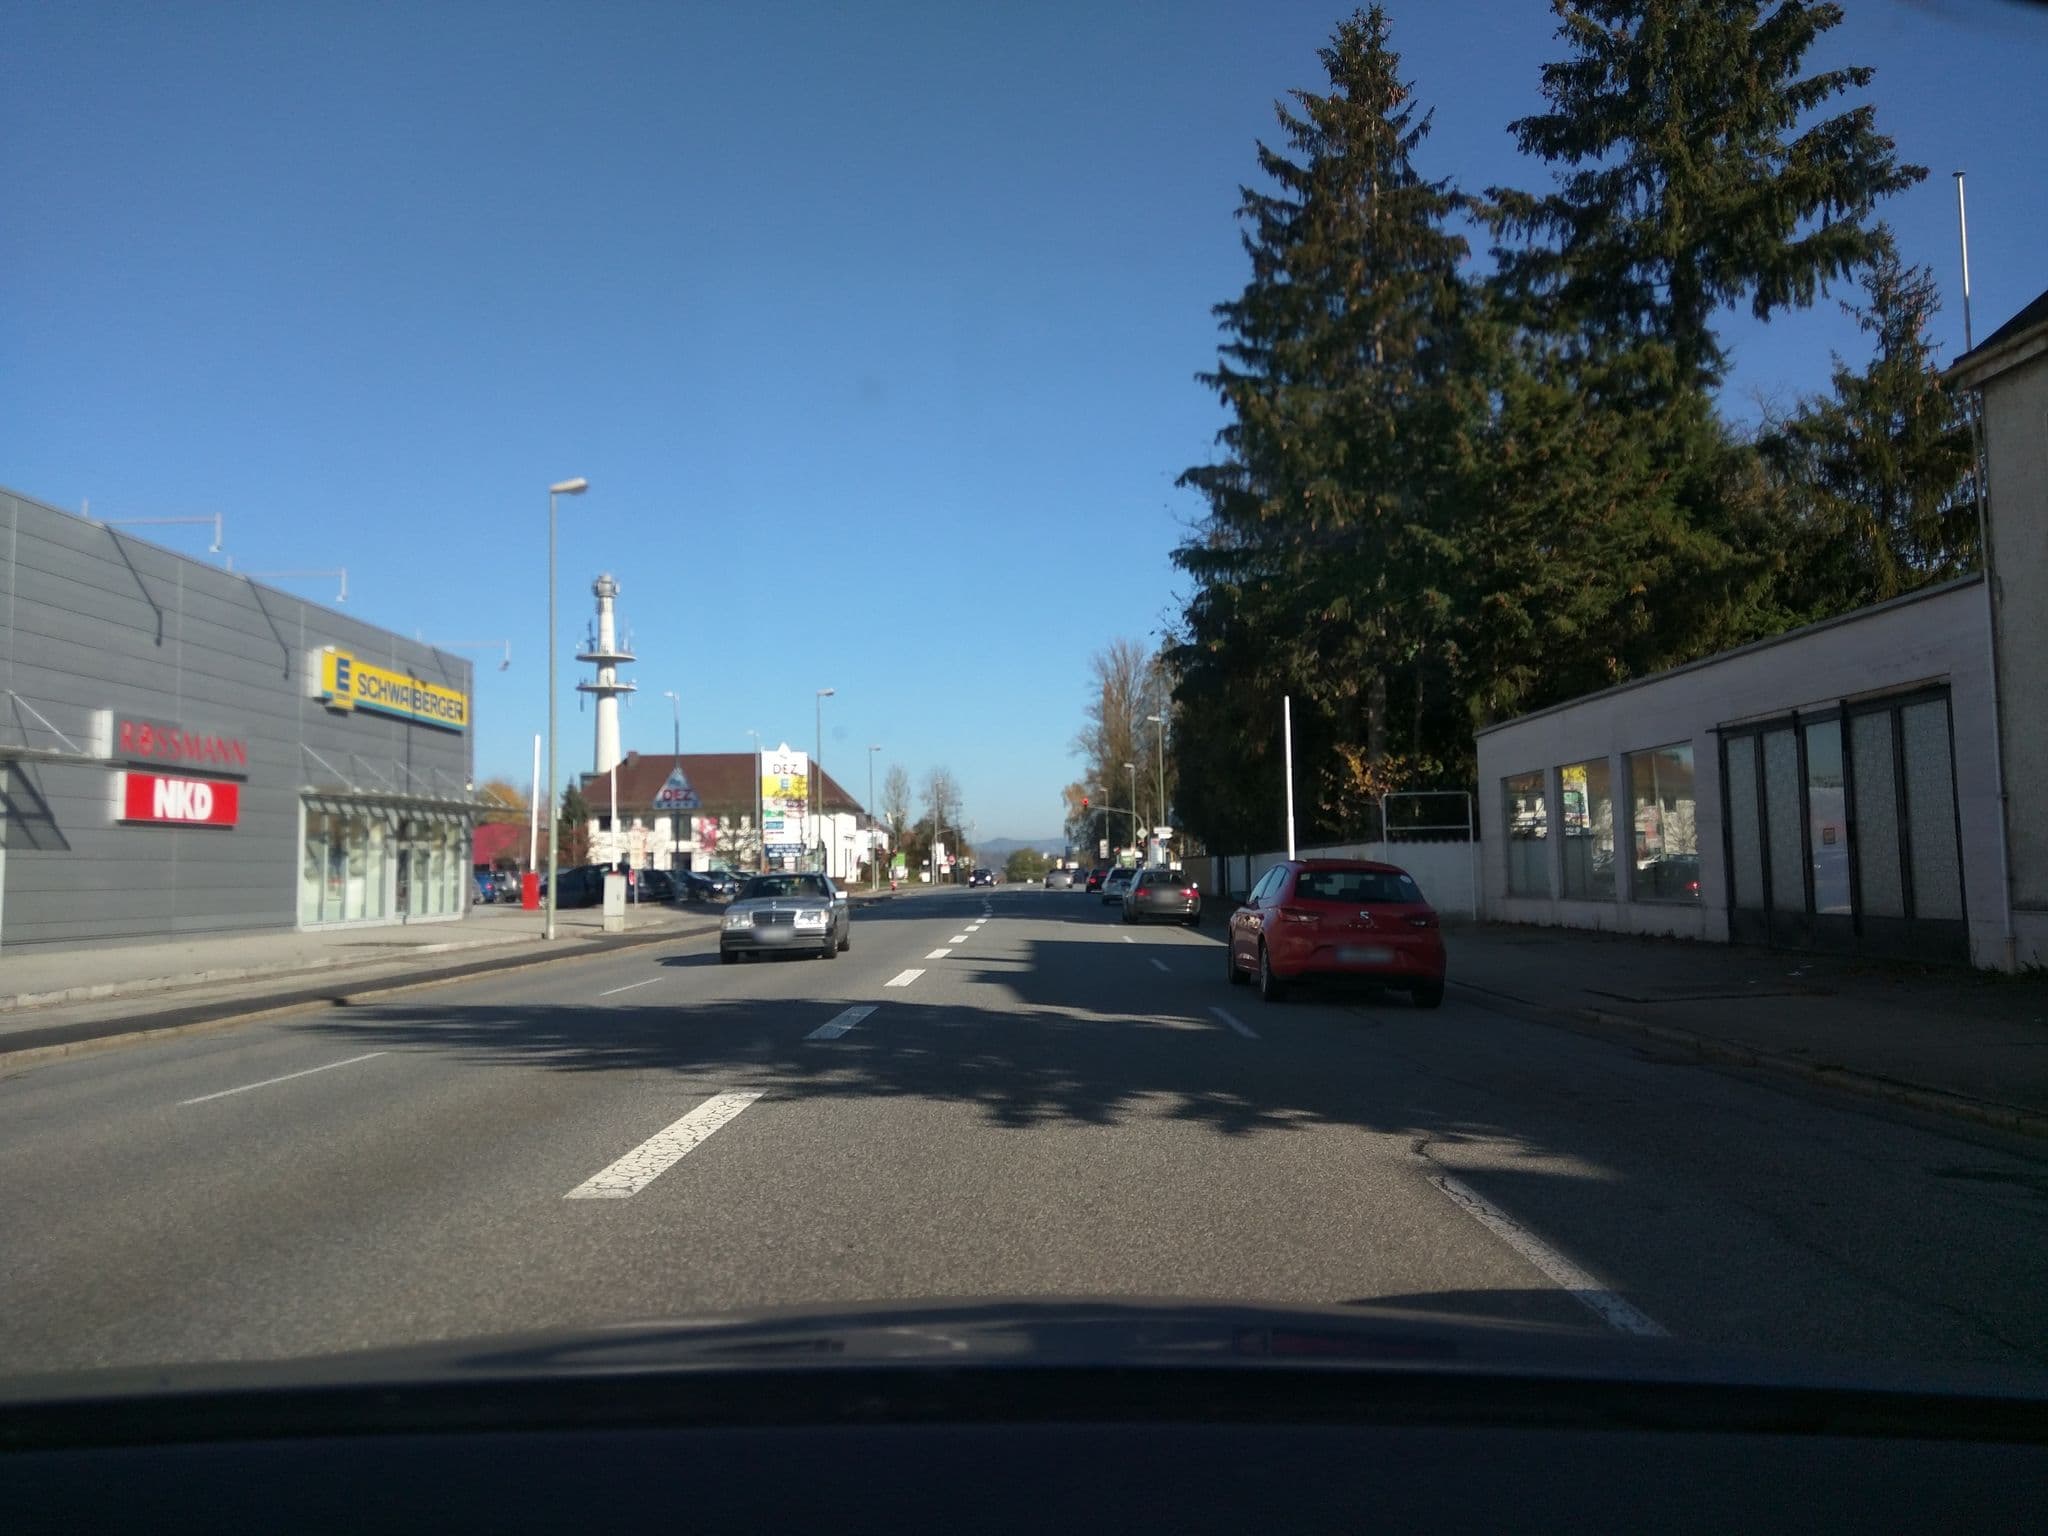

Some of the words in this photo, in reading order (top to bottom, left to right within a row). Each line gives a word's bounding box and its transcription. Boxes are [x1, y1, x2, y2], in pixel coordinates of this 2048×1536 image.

[337, 658, 350, 691] E
[358, 674, 463, 720] SCHWAIBERGER
[119, 720, 248, 767] ROSSMANN
[773, 764, 798, 775] DEZ
[154, 779, 213, 820] NKD
[663, 789, 693, 801] DEZ
